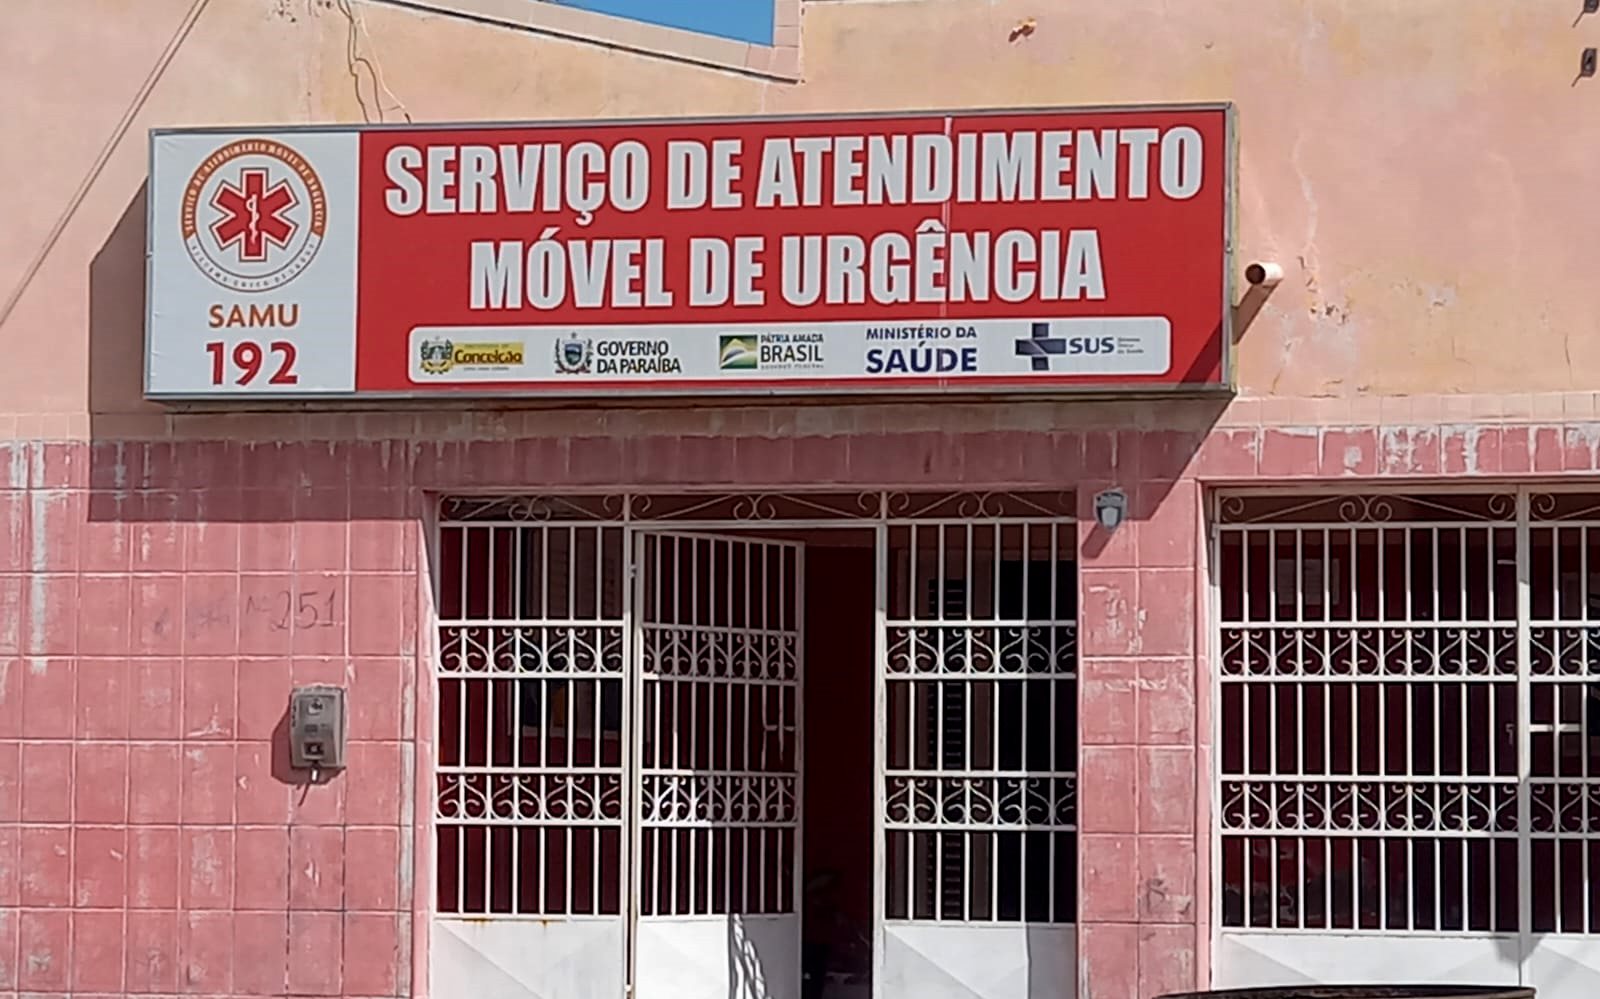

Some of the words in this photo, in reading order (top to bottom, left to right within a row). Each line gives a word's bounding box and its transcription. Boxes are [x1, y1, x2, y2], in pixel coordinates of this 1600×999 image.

[385, 140, 650, 226] SERVIÇO
[667, 139, 742, 210] DE
[755, 126, 1202, 208] ATENDIMENTO
[470, 227, 673, 309] MÓVEL
[689, 236, 764, 307] DE
[781, 218, 1106, 306] URGÊNCIA
[208, 304, 298, 328] SAMU
[793, 333, 824, 343] AMADA
[866, 323, 951, 340] MINISTÉRIO
[956, 326, 977, 338] DA
[597, 341, 669, 356] GOVERNO
[761, 345, 824, 363] BRASIL
[1069, 337, 1114, 354] SUS
[206, 341, 298, 385] 192
[454, 349, 522, 364] Conceição
[597, 358, 617, 373] DA
[620, 356, 681, 373] PARAÍBA
[866, 341, 977, 373] SAÚDE
